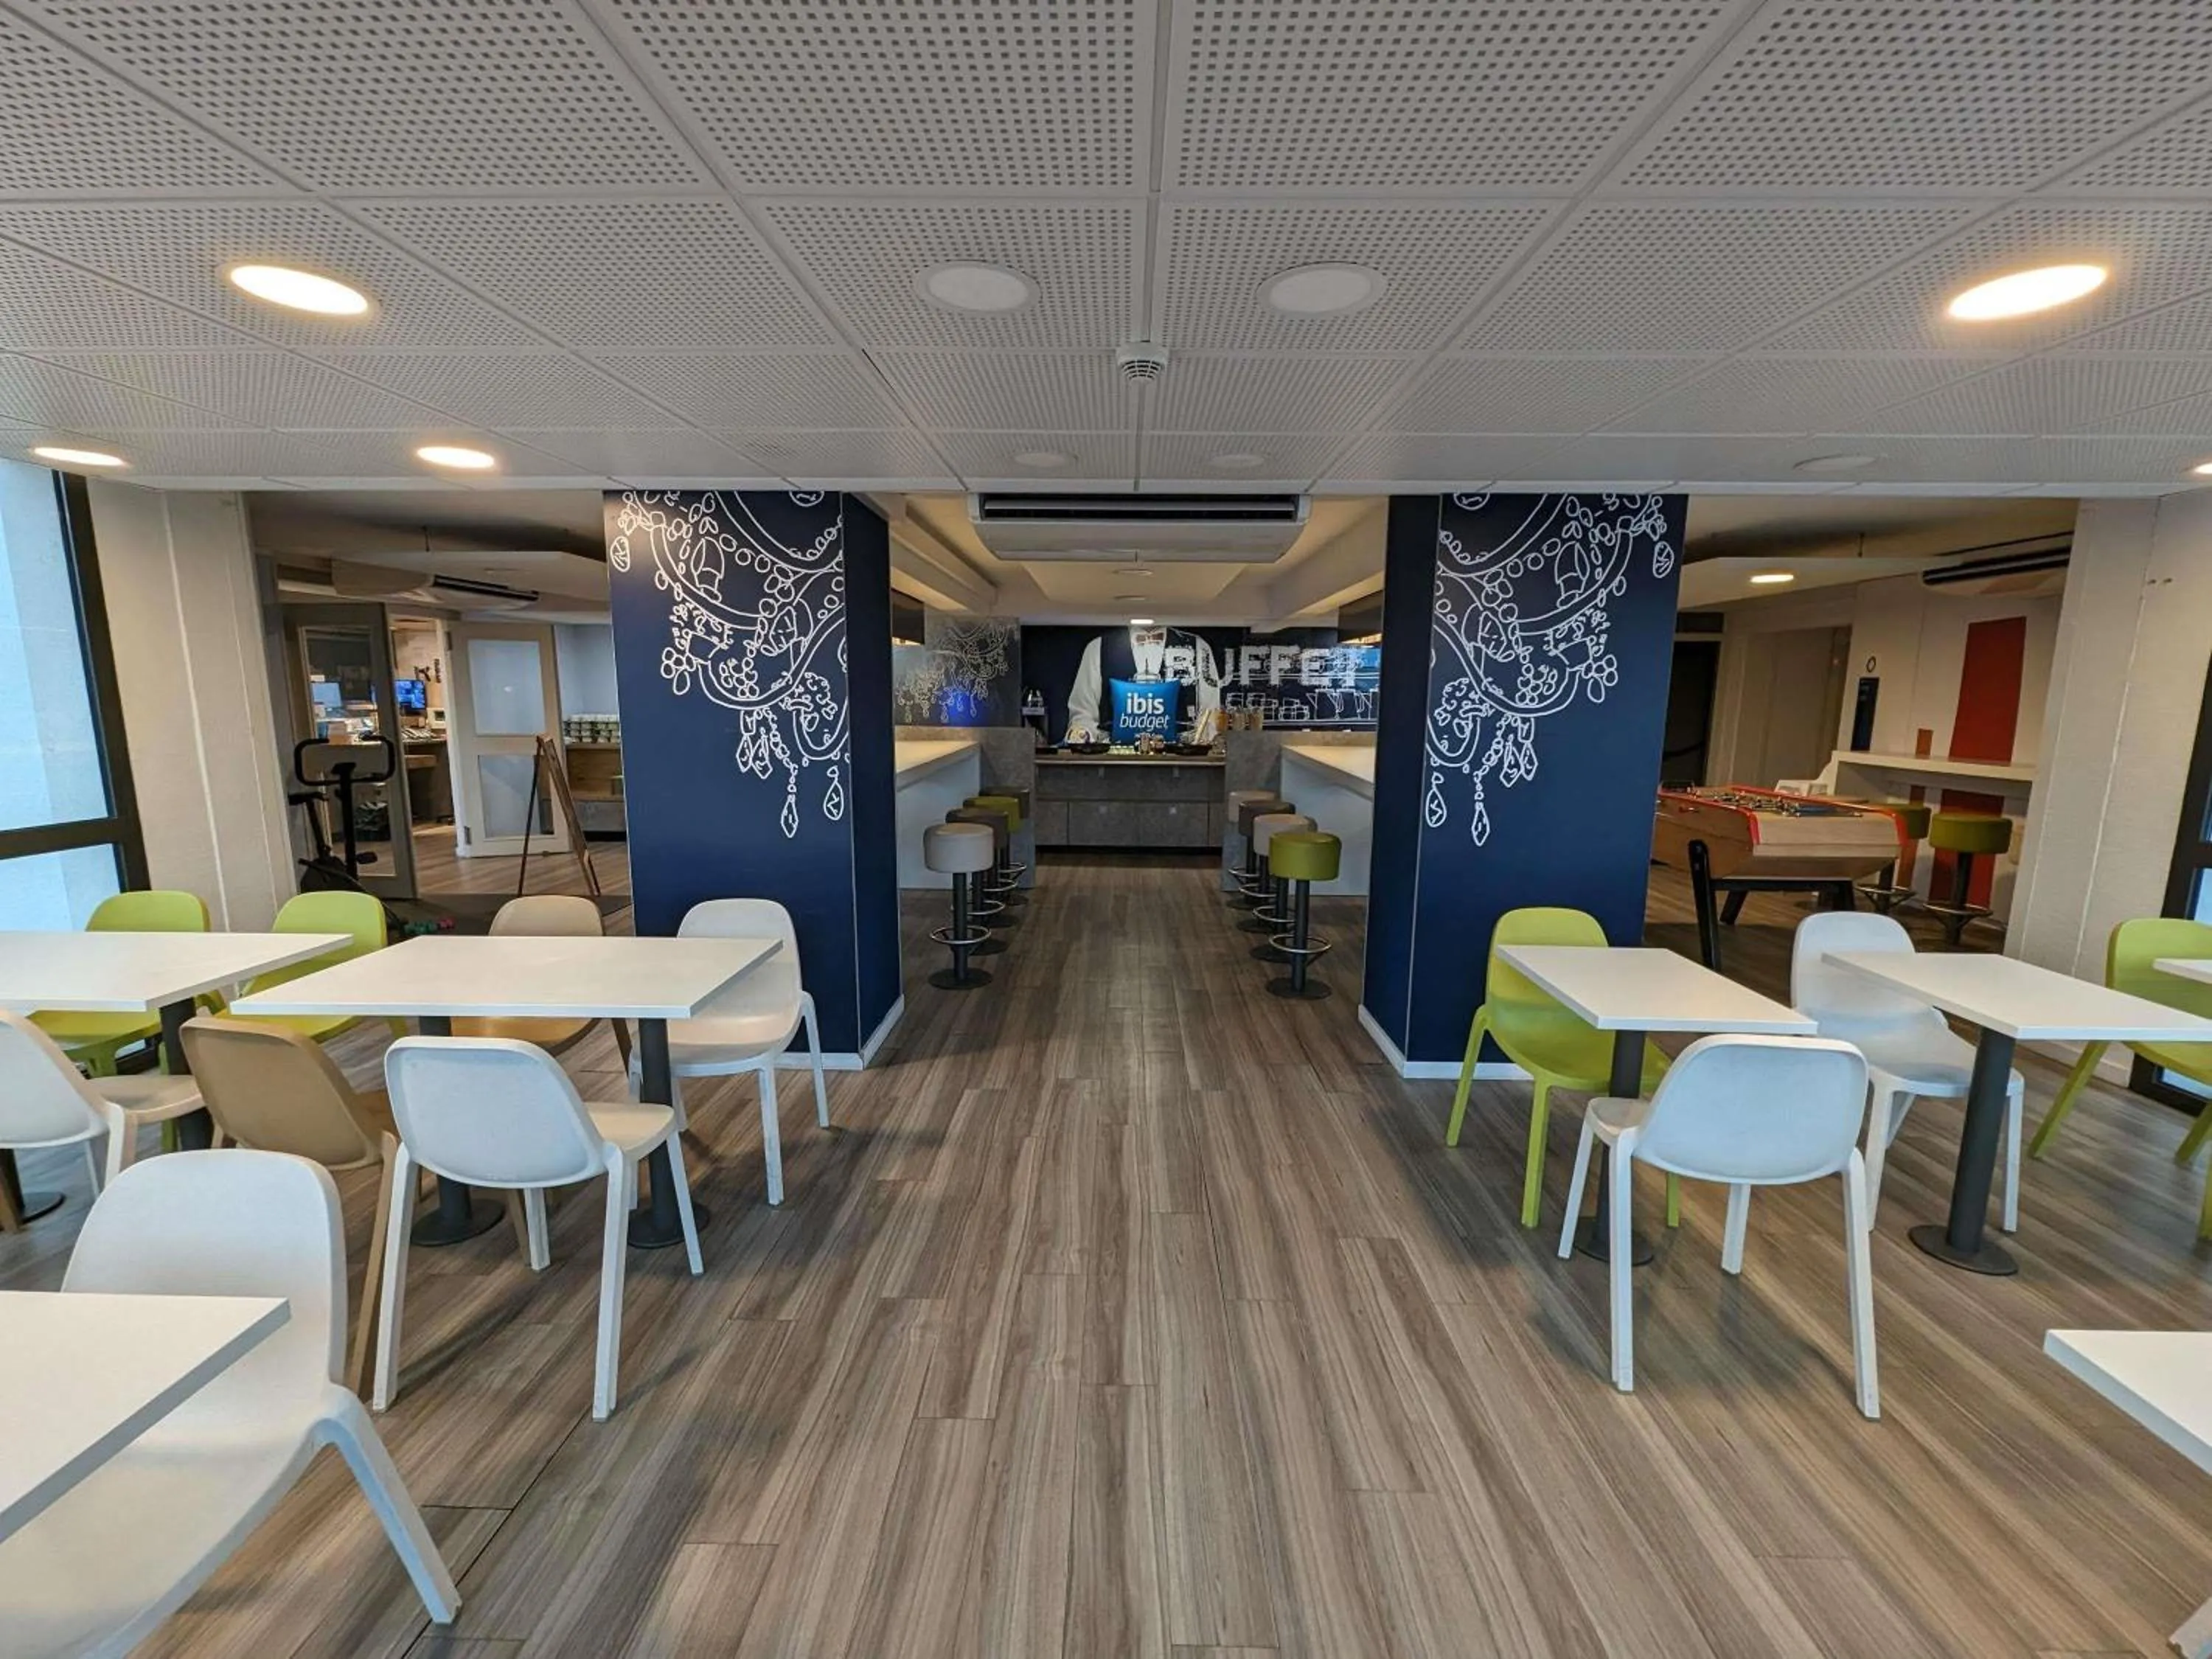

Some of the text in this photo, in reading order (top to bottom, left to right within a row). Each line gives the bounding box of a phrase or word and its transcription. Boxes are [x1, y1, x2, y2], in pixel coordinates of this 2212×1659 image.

[1164, 644, 1359, 687] BUFFET
[1126, 692, 1164, 714] ibis
[1119, 713, 1170, 731] budget
